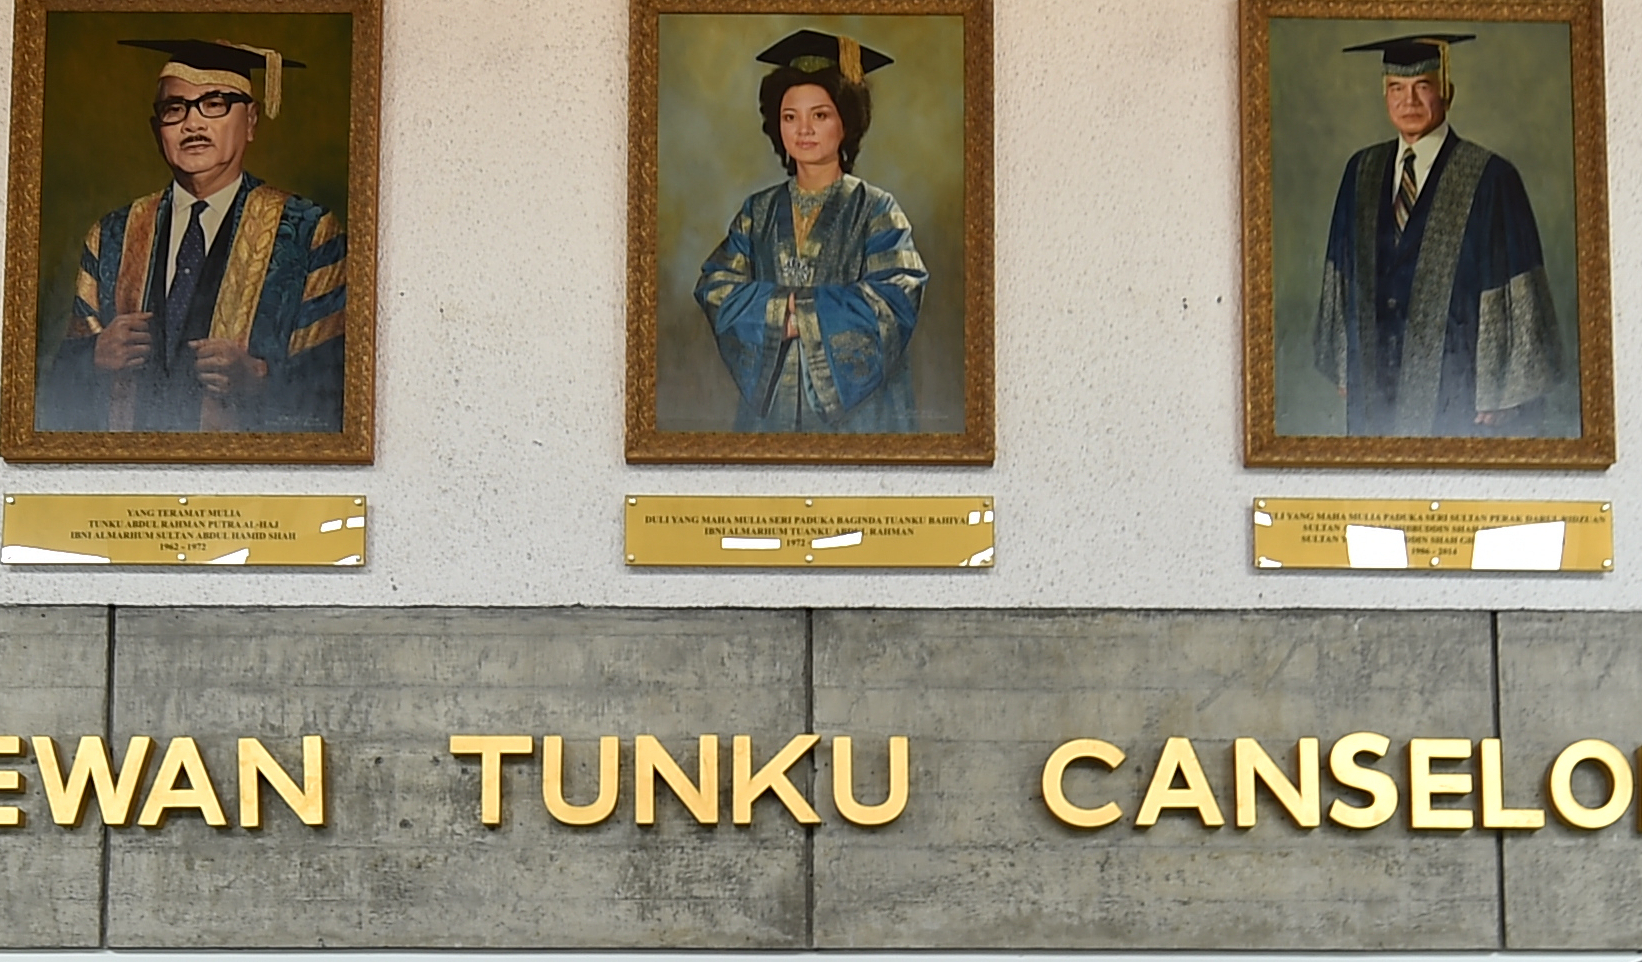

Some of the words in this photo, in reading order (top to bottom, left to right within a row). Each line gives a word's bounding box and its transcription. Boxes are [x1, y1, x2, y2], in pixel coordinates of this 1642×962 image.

[126, 508, 155, 517] YANG
[157, 509, 205, 518] TERAMAT
[208, 509, 241, 518] MULIA
[1287, 512, 1314, 520] YANG
[1316, 512, 1346, 521] MAHA
[89, 520, 123, 528] TUNKU
[126, 520, 158, 528] ABDUL
[161, 520, 205, 528] RAHMAN
[208, 520, 241, 529] PUTRA
[644, 515, 669, 524] DULI
[671, 515, 699, 524] YANG
[701, 515, 731, 524] MAHA
[734, 516, 767, 524] MULIA
[769, 516, 792, 524] SERI
[794, 516, 834, 524] PADUKA
[837, 516, 882, 524] BAGINDA
[884, 516, 926, 525] TUANKU
[928, 516, 969, 525] BAHIYA
[704, 527, 726, 535] IBNI
[790, 527, 832, 536] TUANKU
[869, 527, 914, 536] RAHMAN
[1303, 524, 1340, 532] SULTAN
[70, 531, 92, 539] IBNI
[156, 531, 194, 540] SULTAN
[197, 531, 228, 540] ABDUL
[231, 532, 266, 540] HAMID
[268, 532, 296, 540] SHAH
[450, 734, 910, 827] TUNKU
